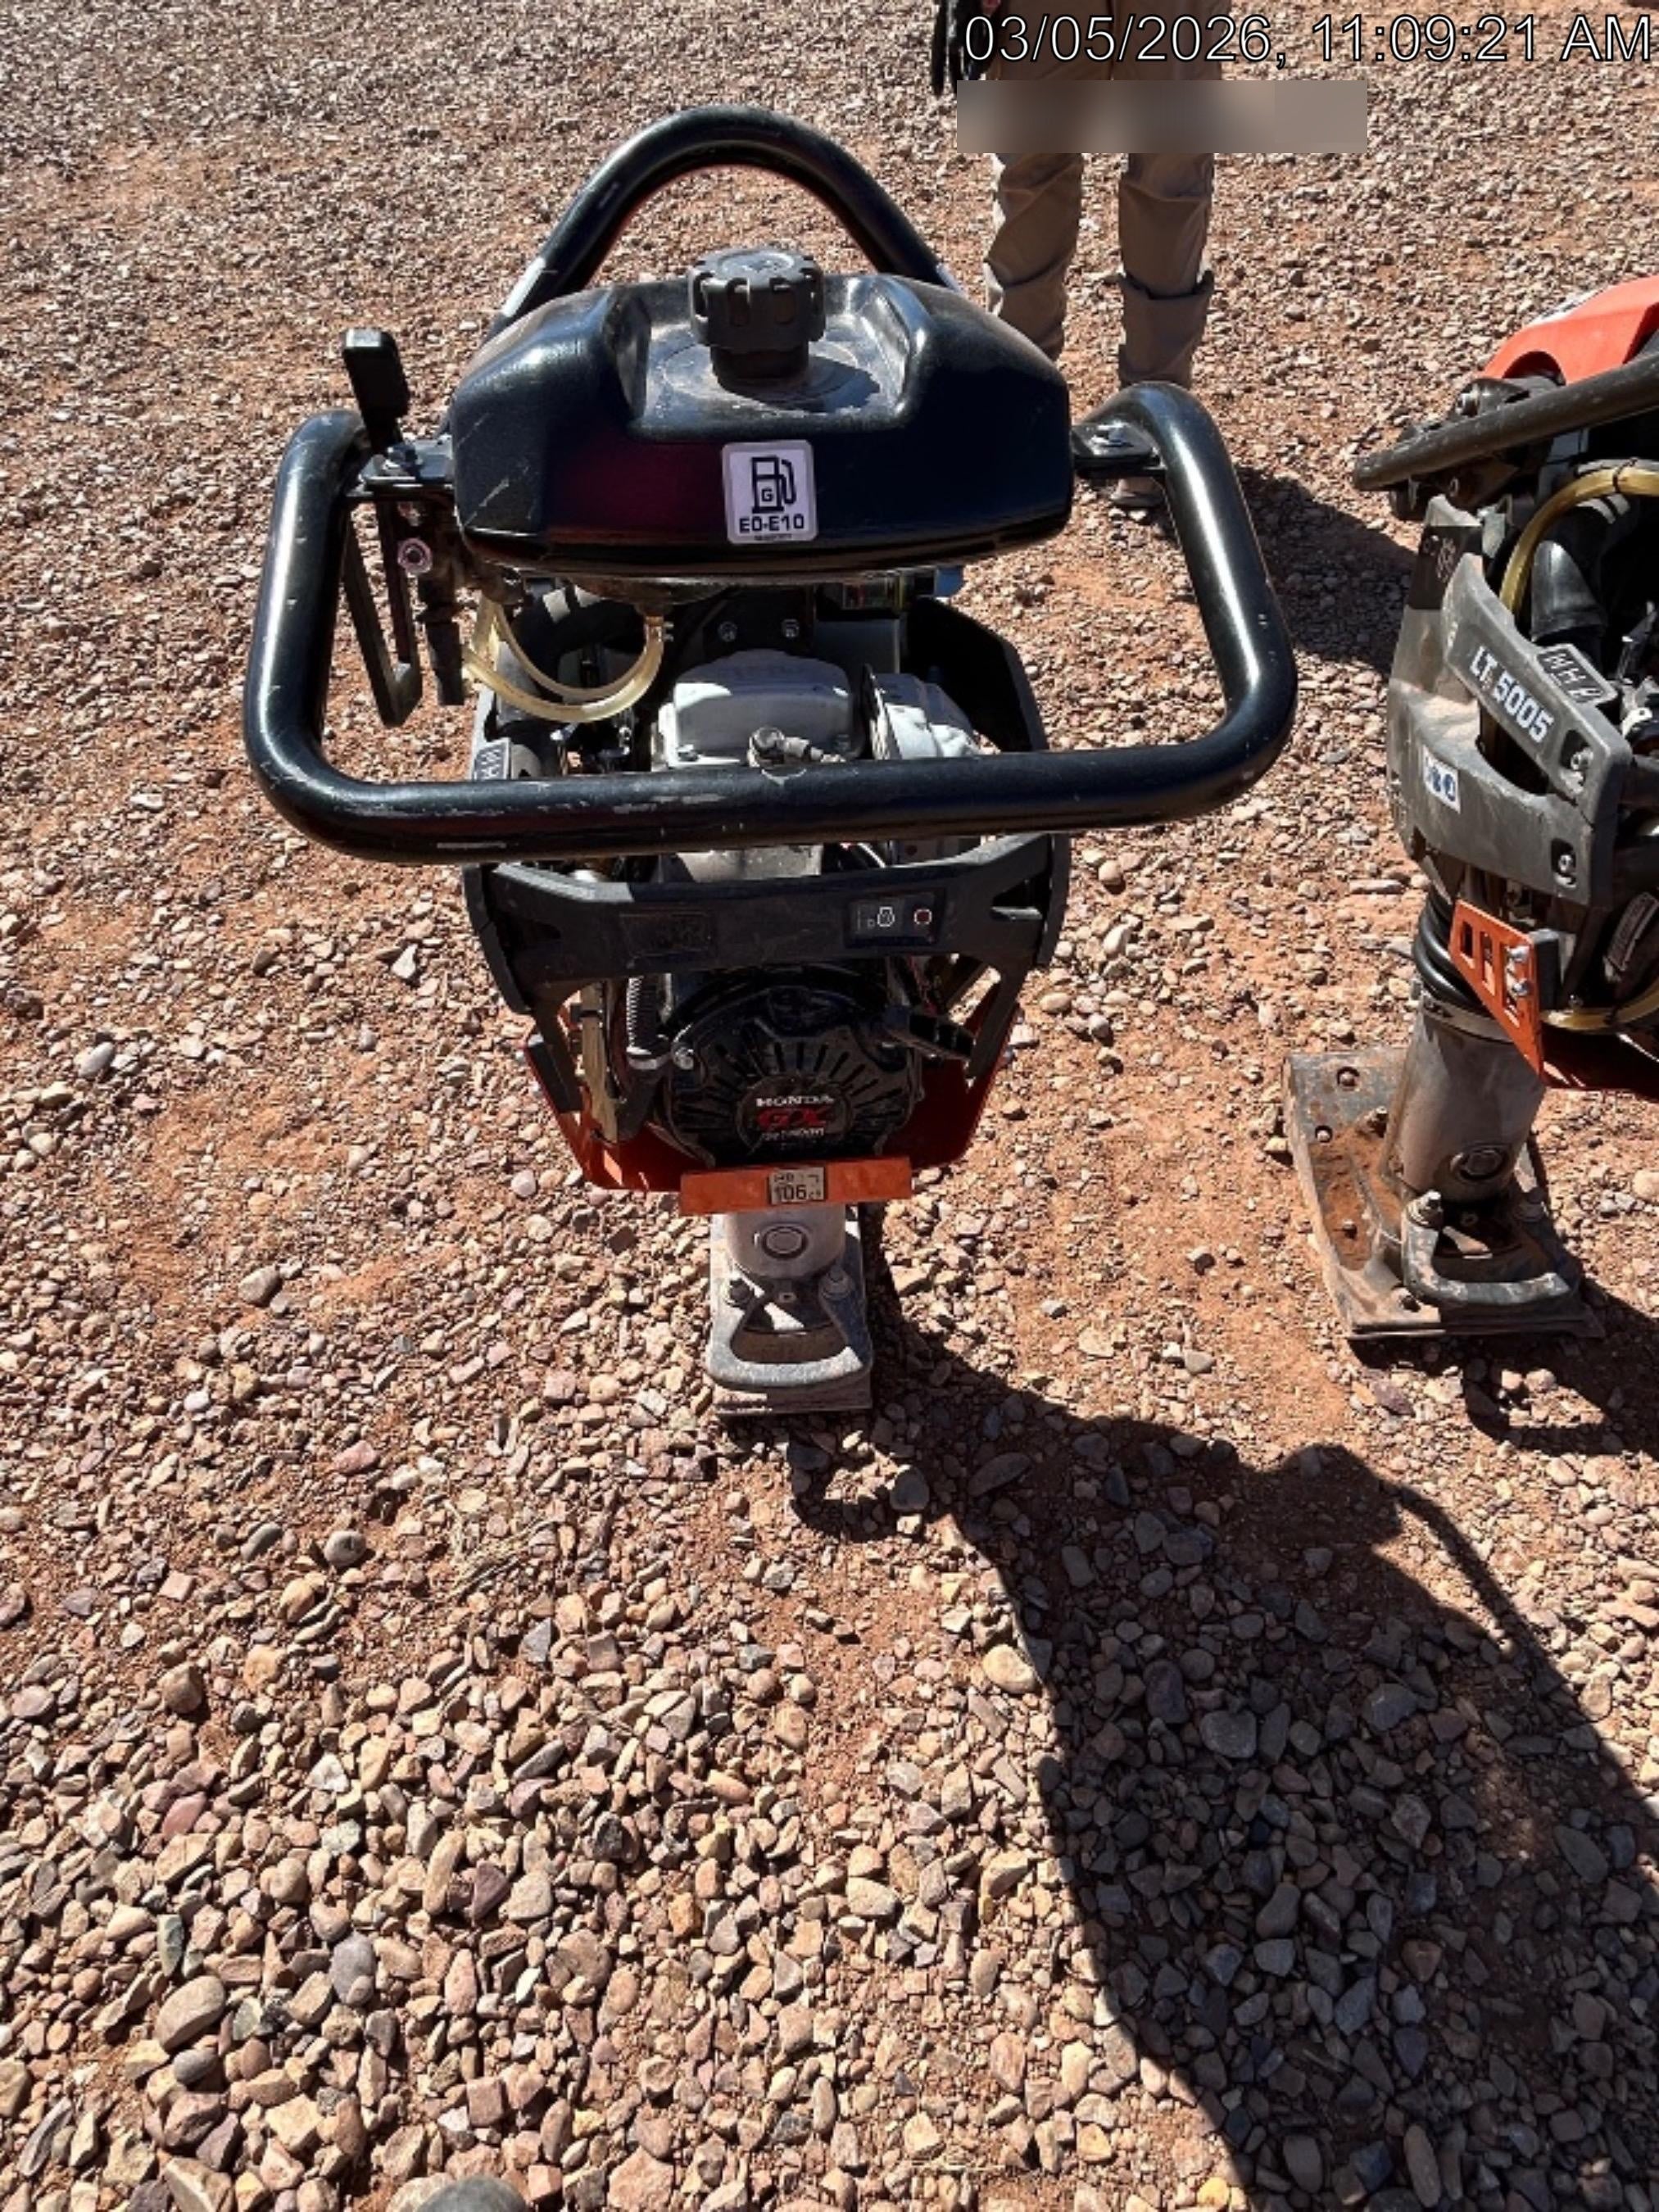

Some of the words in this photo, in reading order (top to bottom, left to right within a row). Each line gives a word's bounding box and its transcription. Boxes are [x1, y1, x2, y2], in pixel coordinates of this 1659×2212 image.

[761, 488, 773, 502] G
[1470, 646, 1497, 682] LT
[1492, 673, 1554, 743] 5005
[756, 1095, 834, 1107] HONDA
